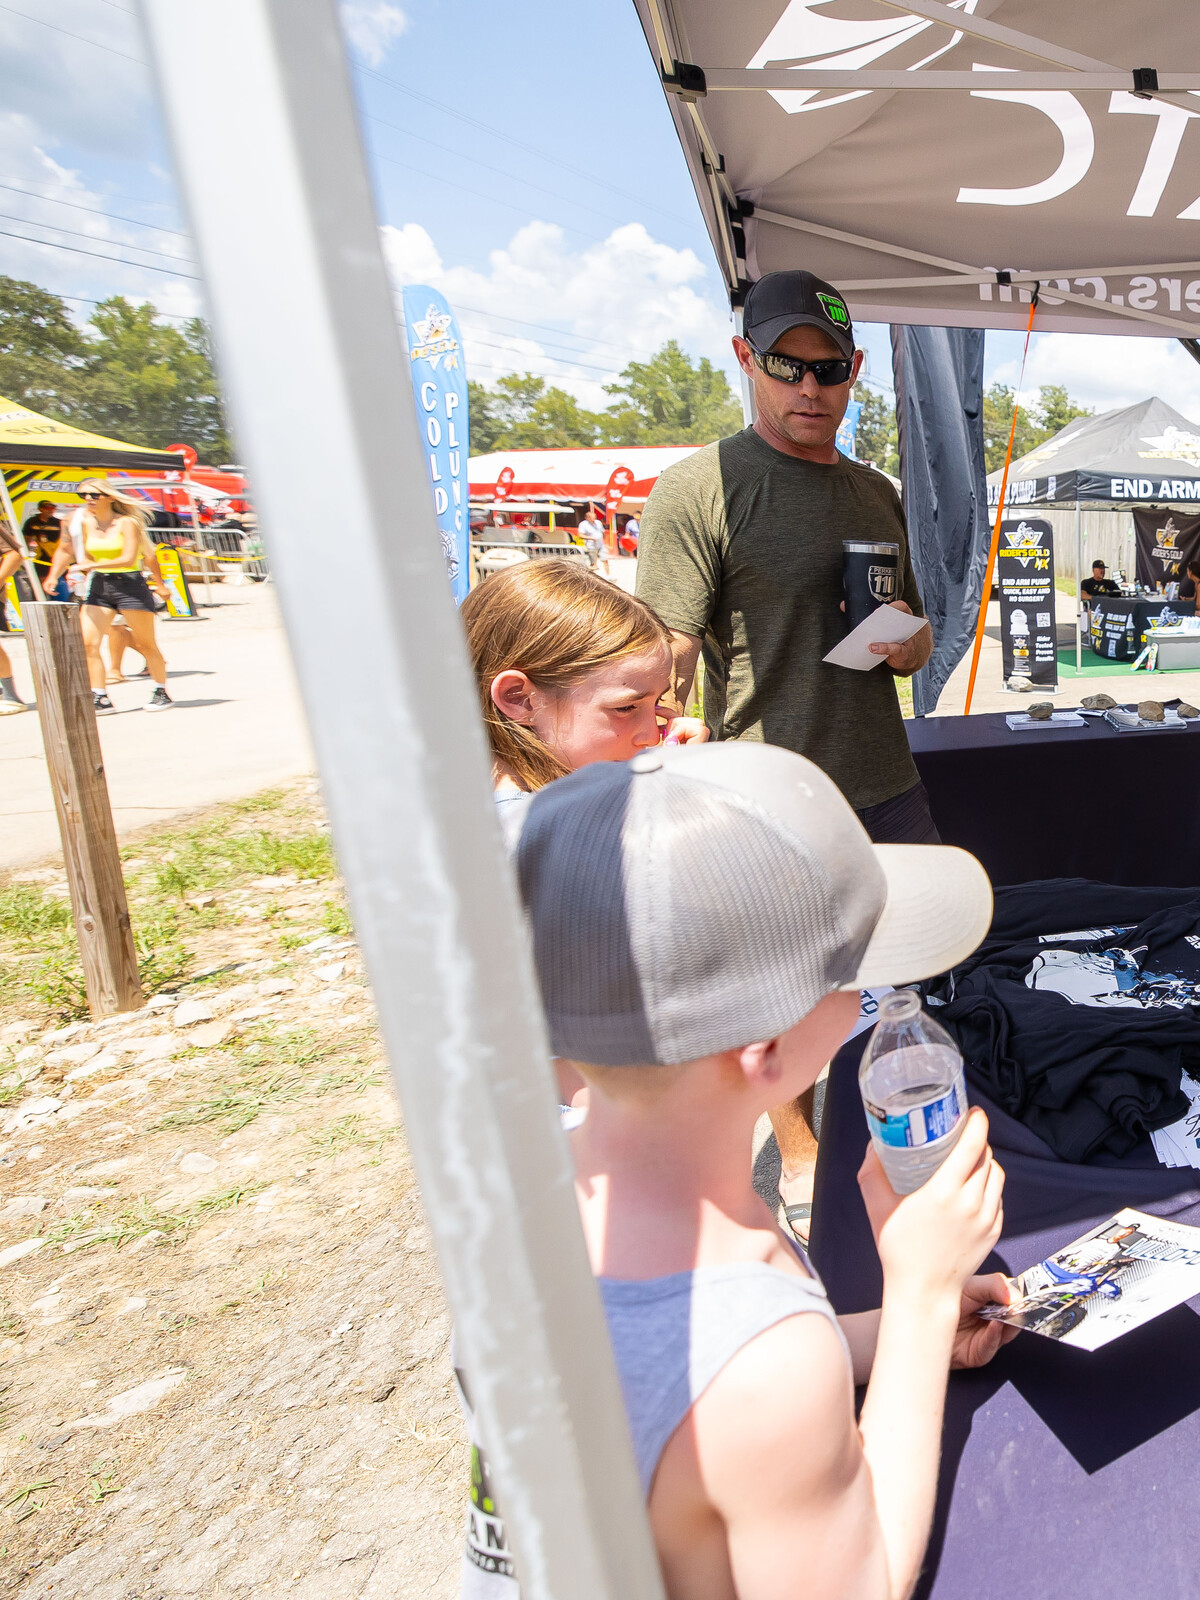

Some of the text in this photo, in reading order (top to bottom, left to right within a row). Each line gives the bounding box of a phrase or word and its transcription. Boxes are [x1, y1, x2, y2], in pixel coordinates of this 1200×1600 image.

[829, 305, 846, 322] 110
[421, 381, 449, 515] COLD
[1110, 478, 1154, 499] END
[999, 548, 1050, 558] RIDER'S GOLD
[1034, 557, 1050, 571] MX
[1002, 578, 1015, 586] END
[1031, 577, 1051, 585] PUMP
